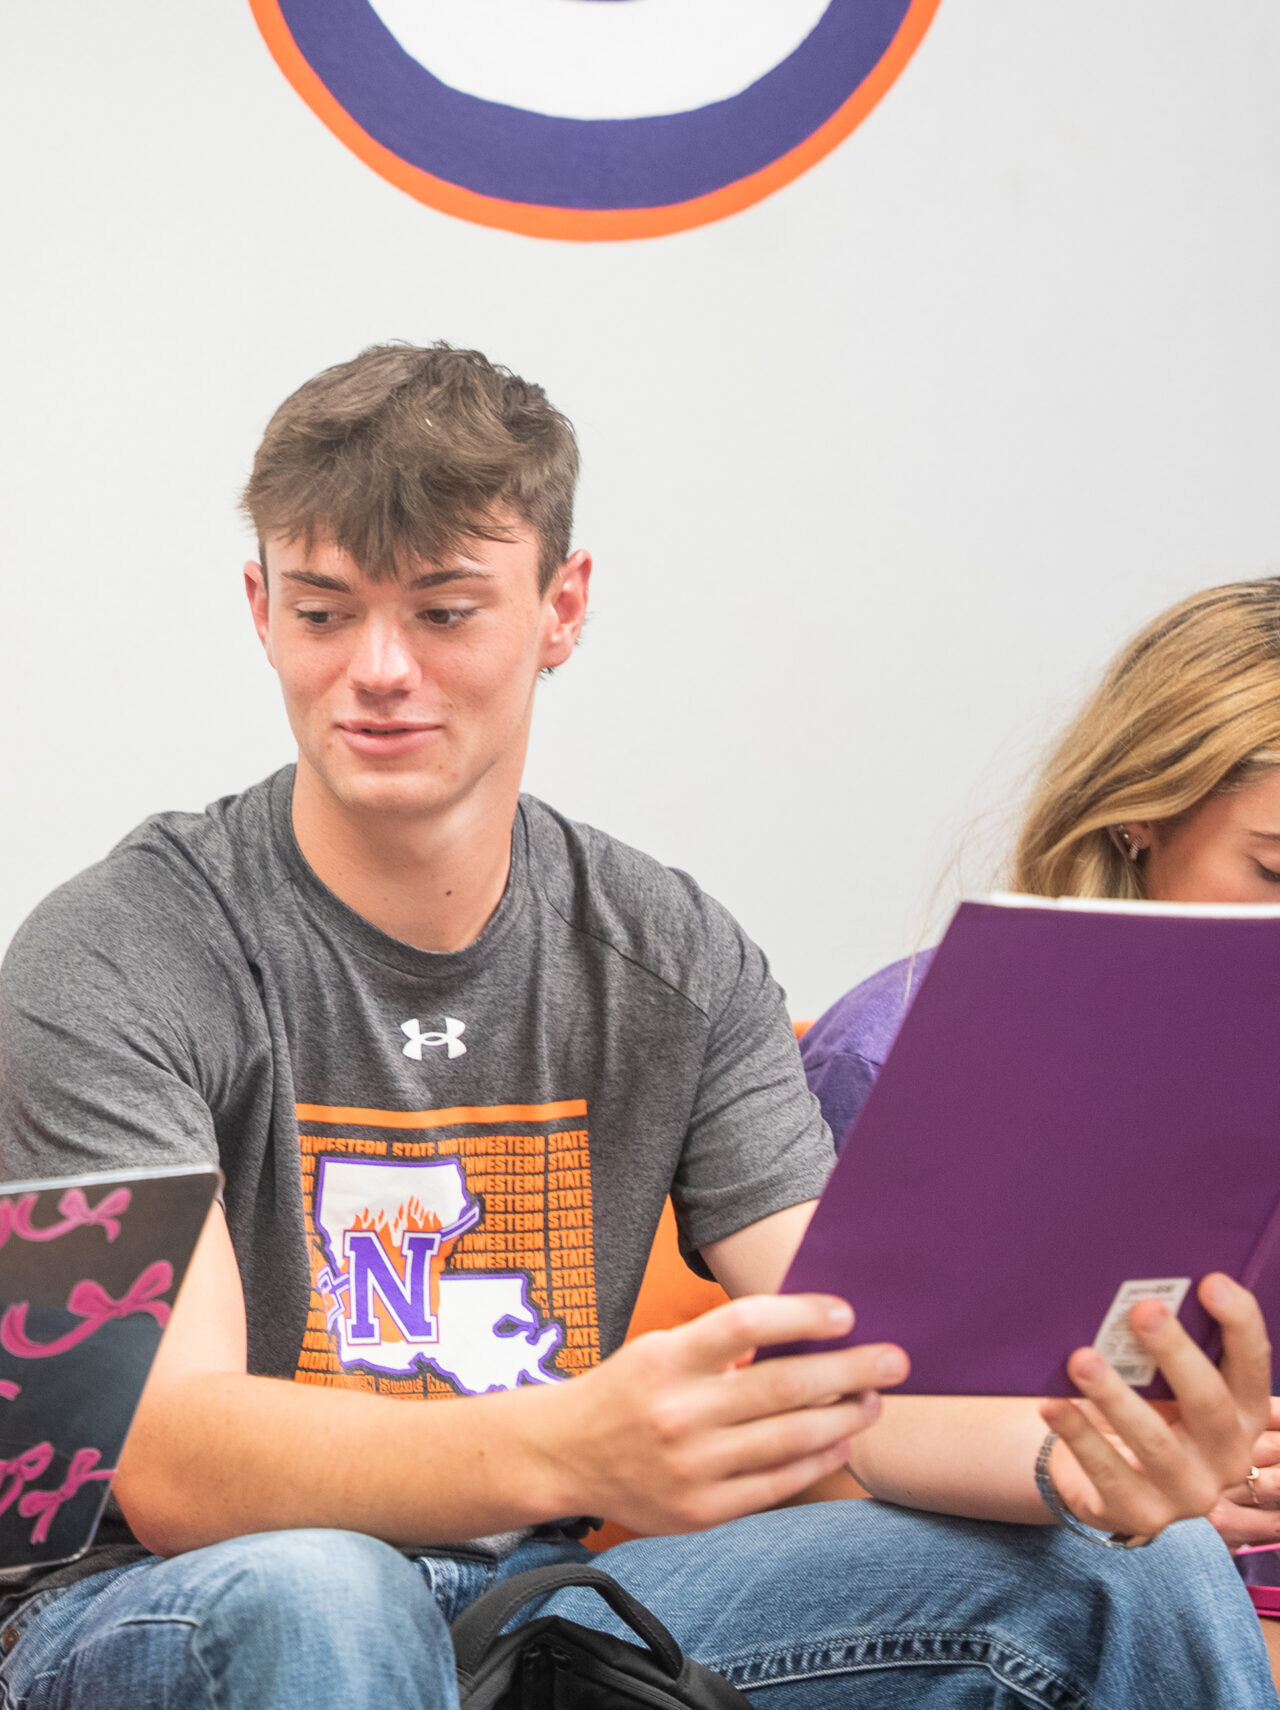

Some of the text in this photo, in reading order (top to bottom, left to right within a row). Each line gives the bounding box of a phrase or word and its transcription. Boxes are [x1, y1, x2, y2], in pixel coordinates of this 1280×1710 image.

[548, 1130, 590, 1153] STATE
[548, 1149, 591, 1172] STATE
[548, 1169, 592, 1191] STATE
[482, 1188, 593, 1212] ESTERN STATE
[475, 1208, 594, 1232] ESTERN STATE
[548, 1227, 594, 1249] STATE
[450, 1247, 595, 1270] THWESTERN STATE
[343, 1229, 439, 1345] N
[551, 1267, 596, 1288] STATE
[552, 1287, 598, 1308] STATE
